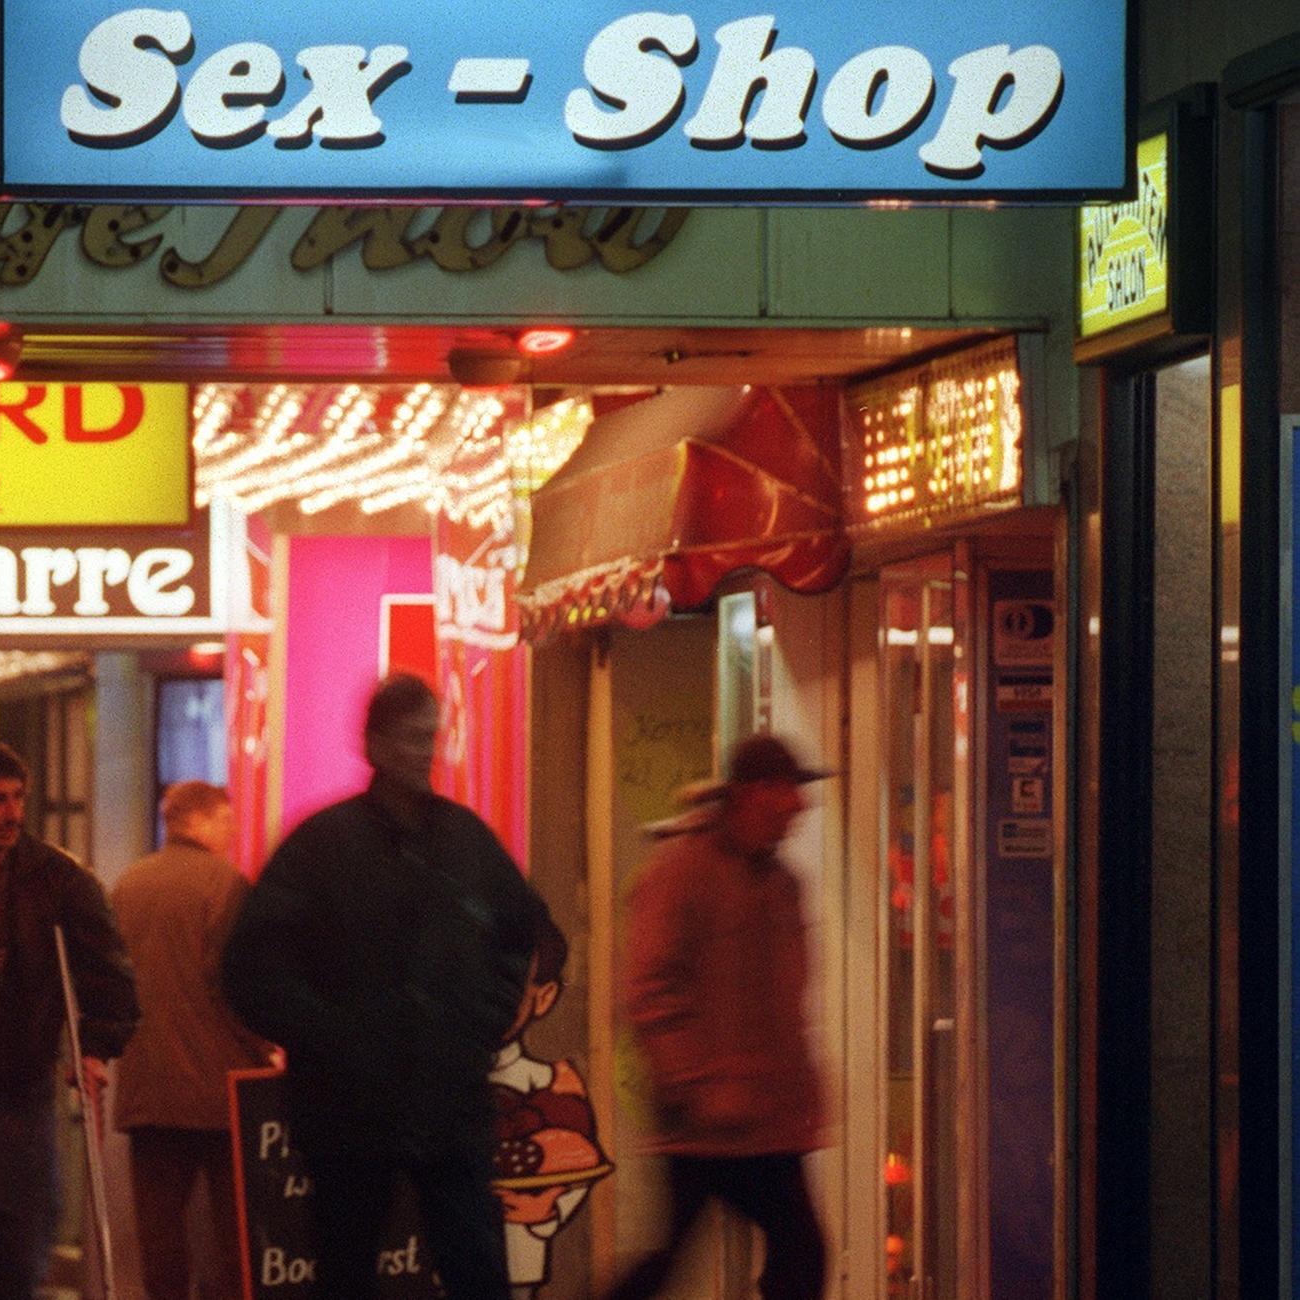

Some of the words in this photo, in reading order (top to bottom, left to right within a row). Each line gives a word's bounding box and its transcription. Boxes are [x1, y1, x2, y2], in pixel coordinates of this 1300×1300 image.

[61, 9, 411, 146] Sex
[564, 11, 1064, 178] Shop
[1108, 248, 1146, 311] SALON
